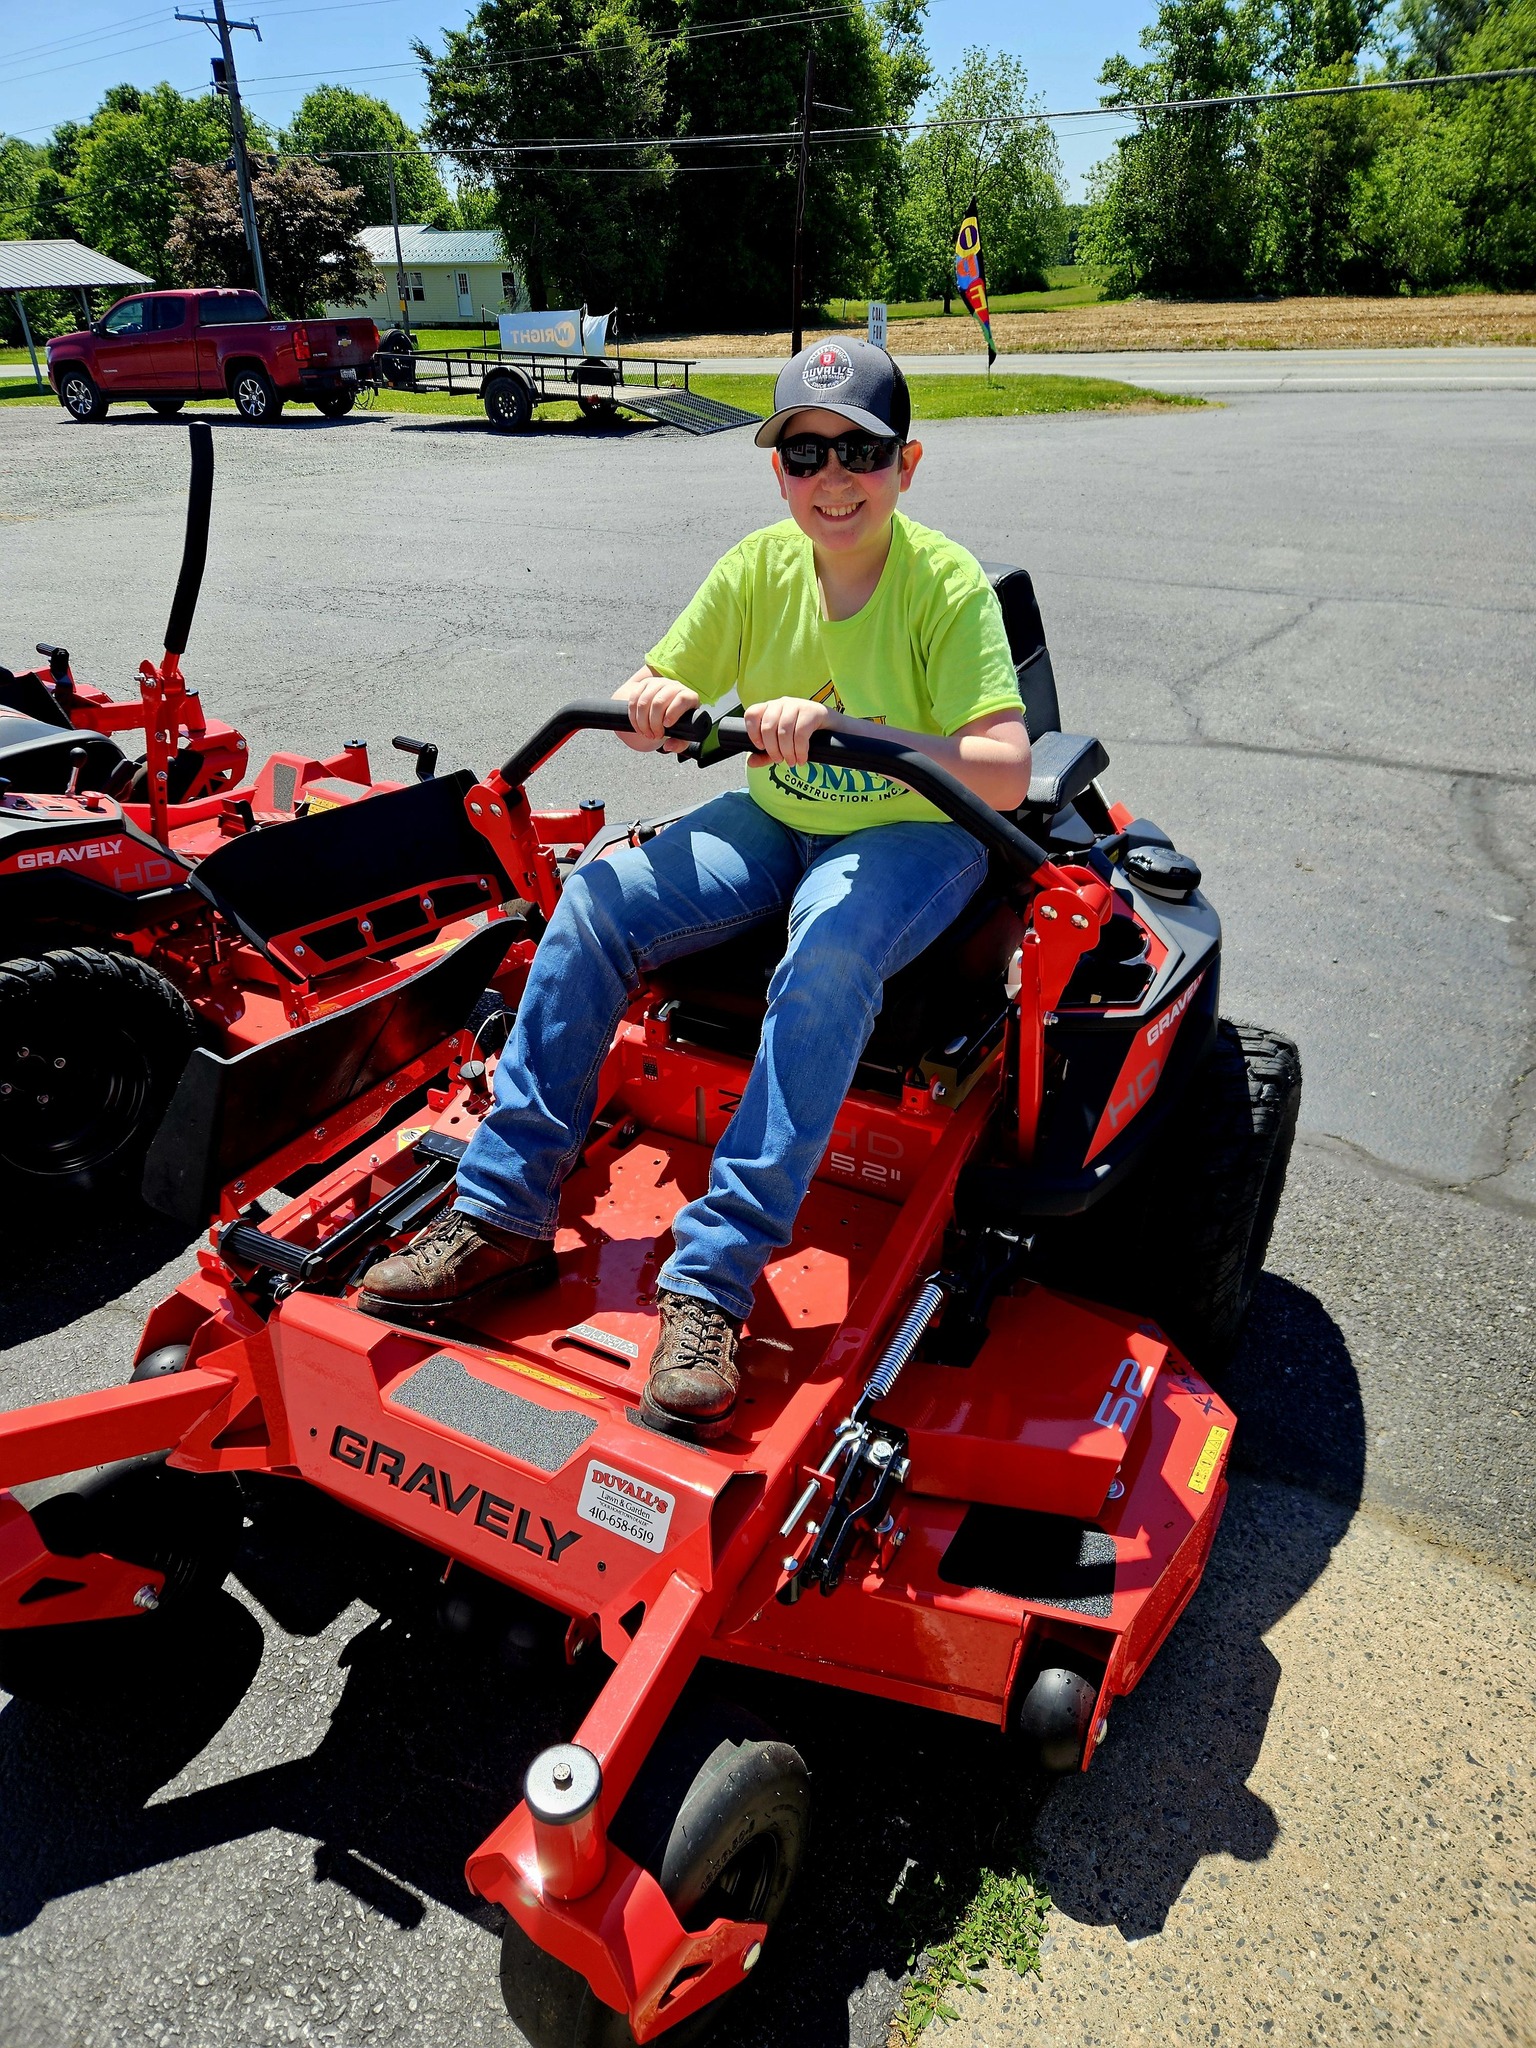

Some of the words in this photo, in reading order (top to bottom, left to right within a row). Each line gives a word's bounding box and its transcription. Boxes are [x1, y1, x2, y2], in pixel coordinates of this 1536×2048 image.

[873, 325, 882, 340] FOR
[802, 366, 855, 380] DUVALL'S
[790, 761, 894, 793] OME
[878, 787, 901, 801] INC.
[17, 839, 122, 869] GRAVELY
[113, 859, 172, 889] HD
[1107, 1058, 1161, 1129] HD
[1093, 1358, 1155, 1433] 52
[329, 1425, 583, 1565] GRAVELY
[591, 1469, 669, 1514] DUVALL'S
[600, 1490, 619, 1506] Lawn
[620, 1499, 625, 1507] &
[625, 1501, 651, 1519] Garden
[589, 1505, 654, 1544] 410-658-6519
